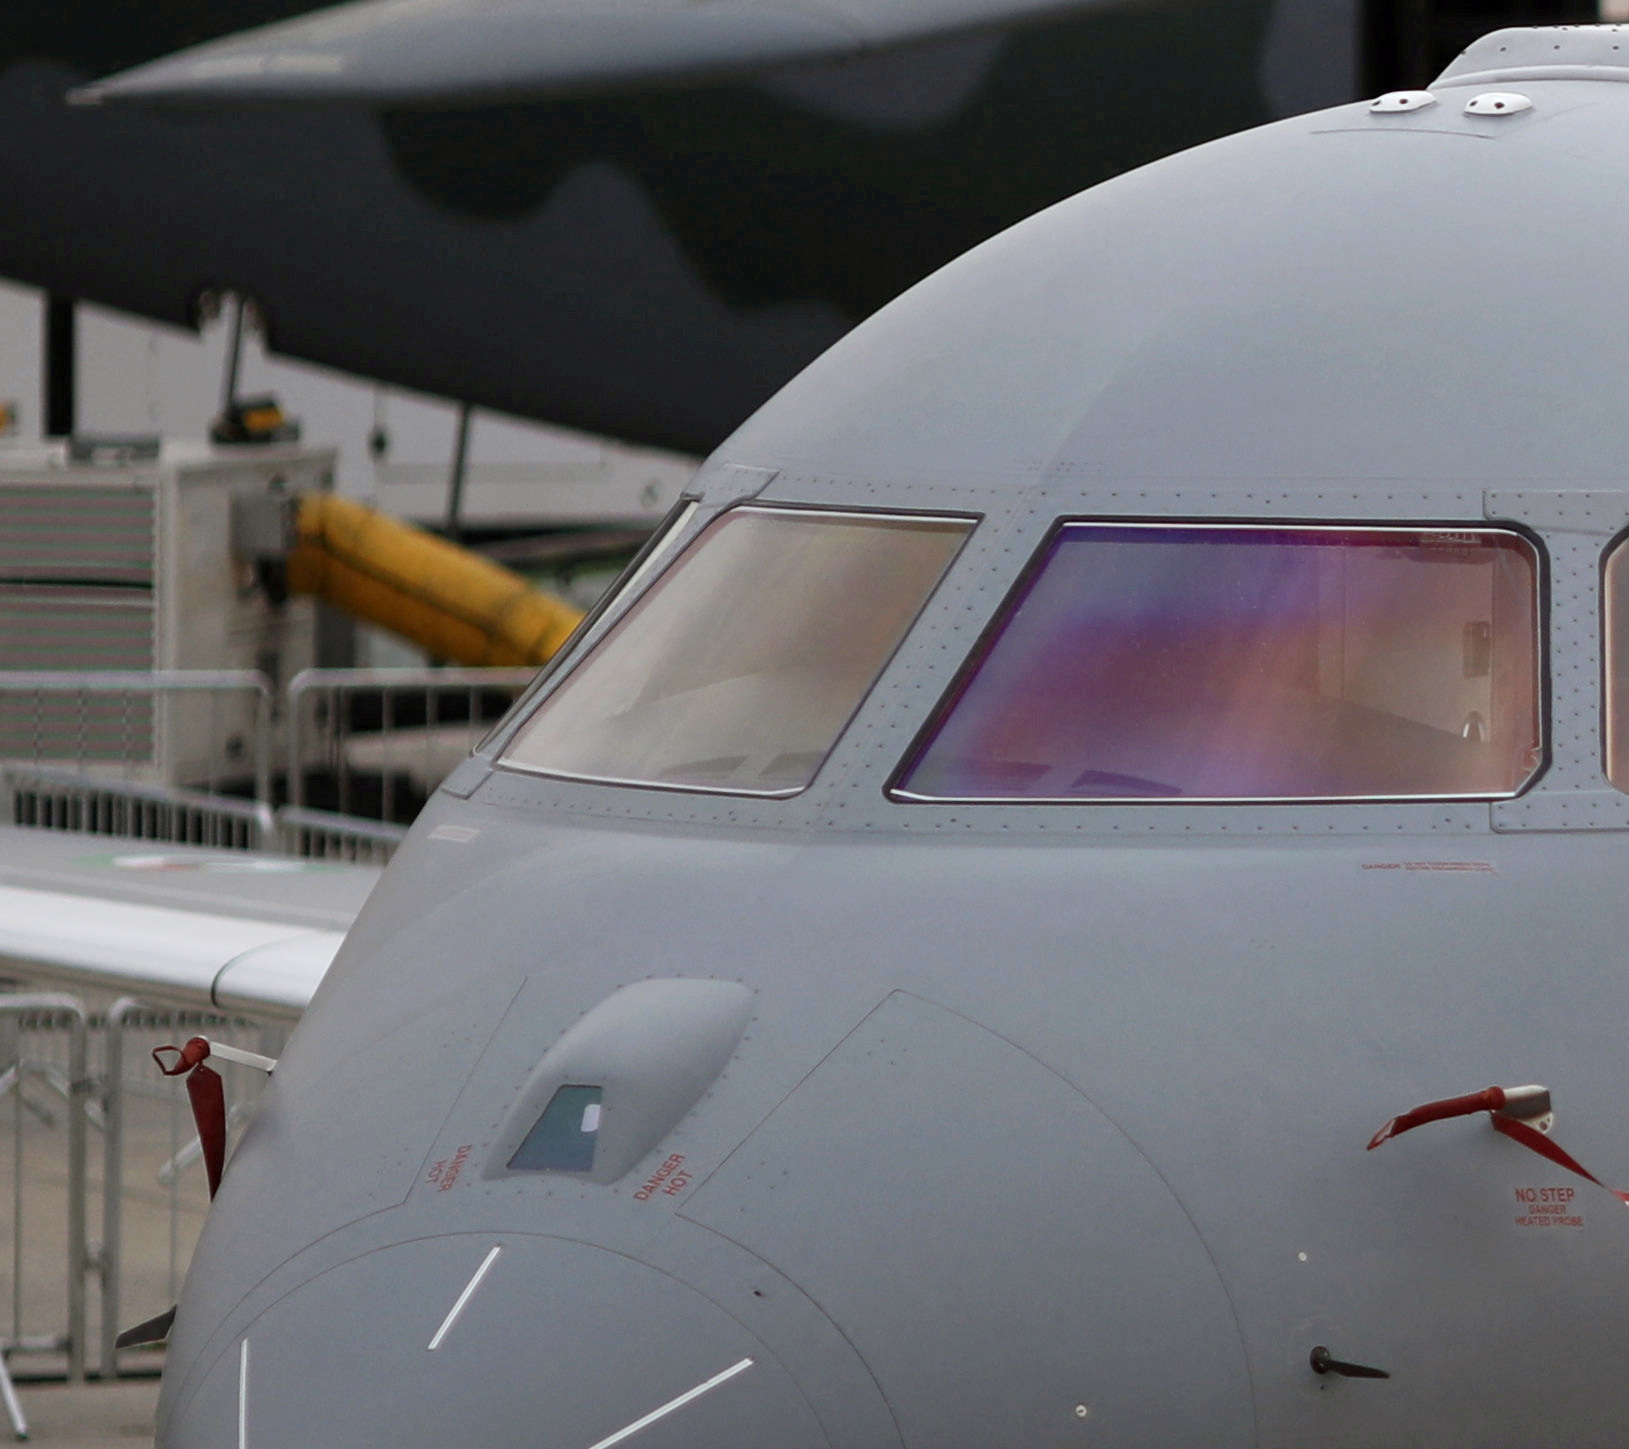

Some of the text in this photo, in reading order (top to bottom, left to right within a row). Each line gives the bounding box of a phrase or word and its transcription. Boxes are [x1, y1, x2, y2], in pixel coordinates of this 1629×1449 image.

[632, 1152, 687, 1202] DANGER
[661, 1168, 694, 1197] HOT
[1514, 1187, 1575, 1203] NO STEP
[1528, 1204, 1566, 1215] DANGER
[1514, 1215, 1584, 1227] HEATED PROBE
